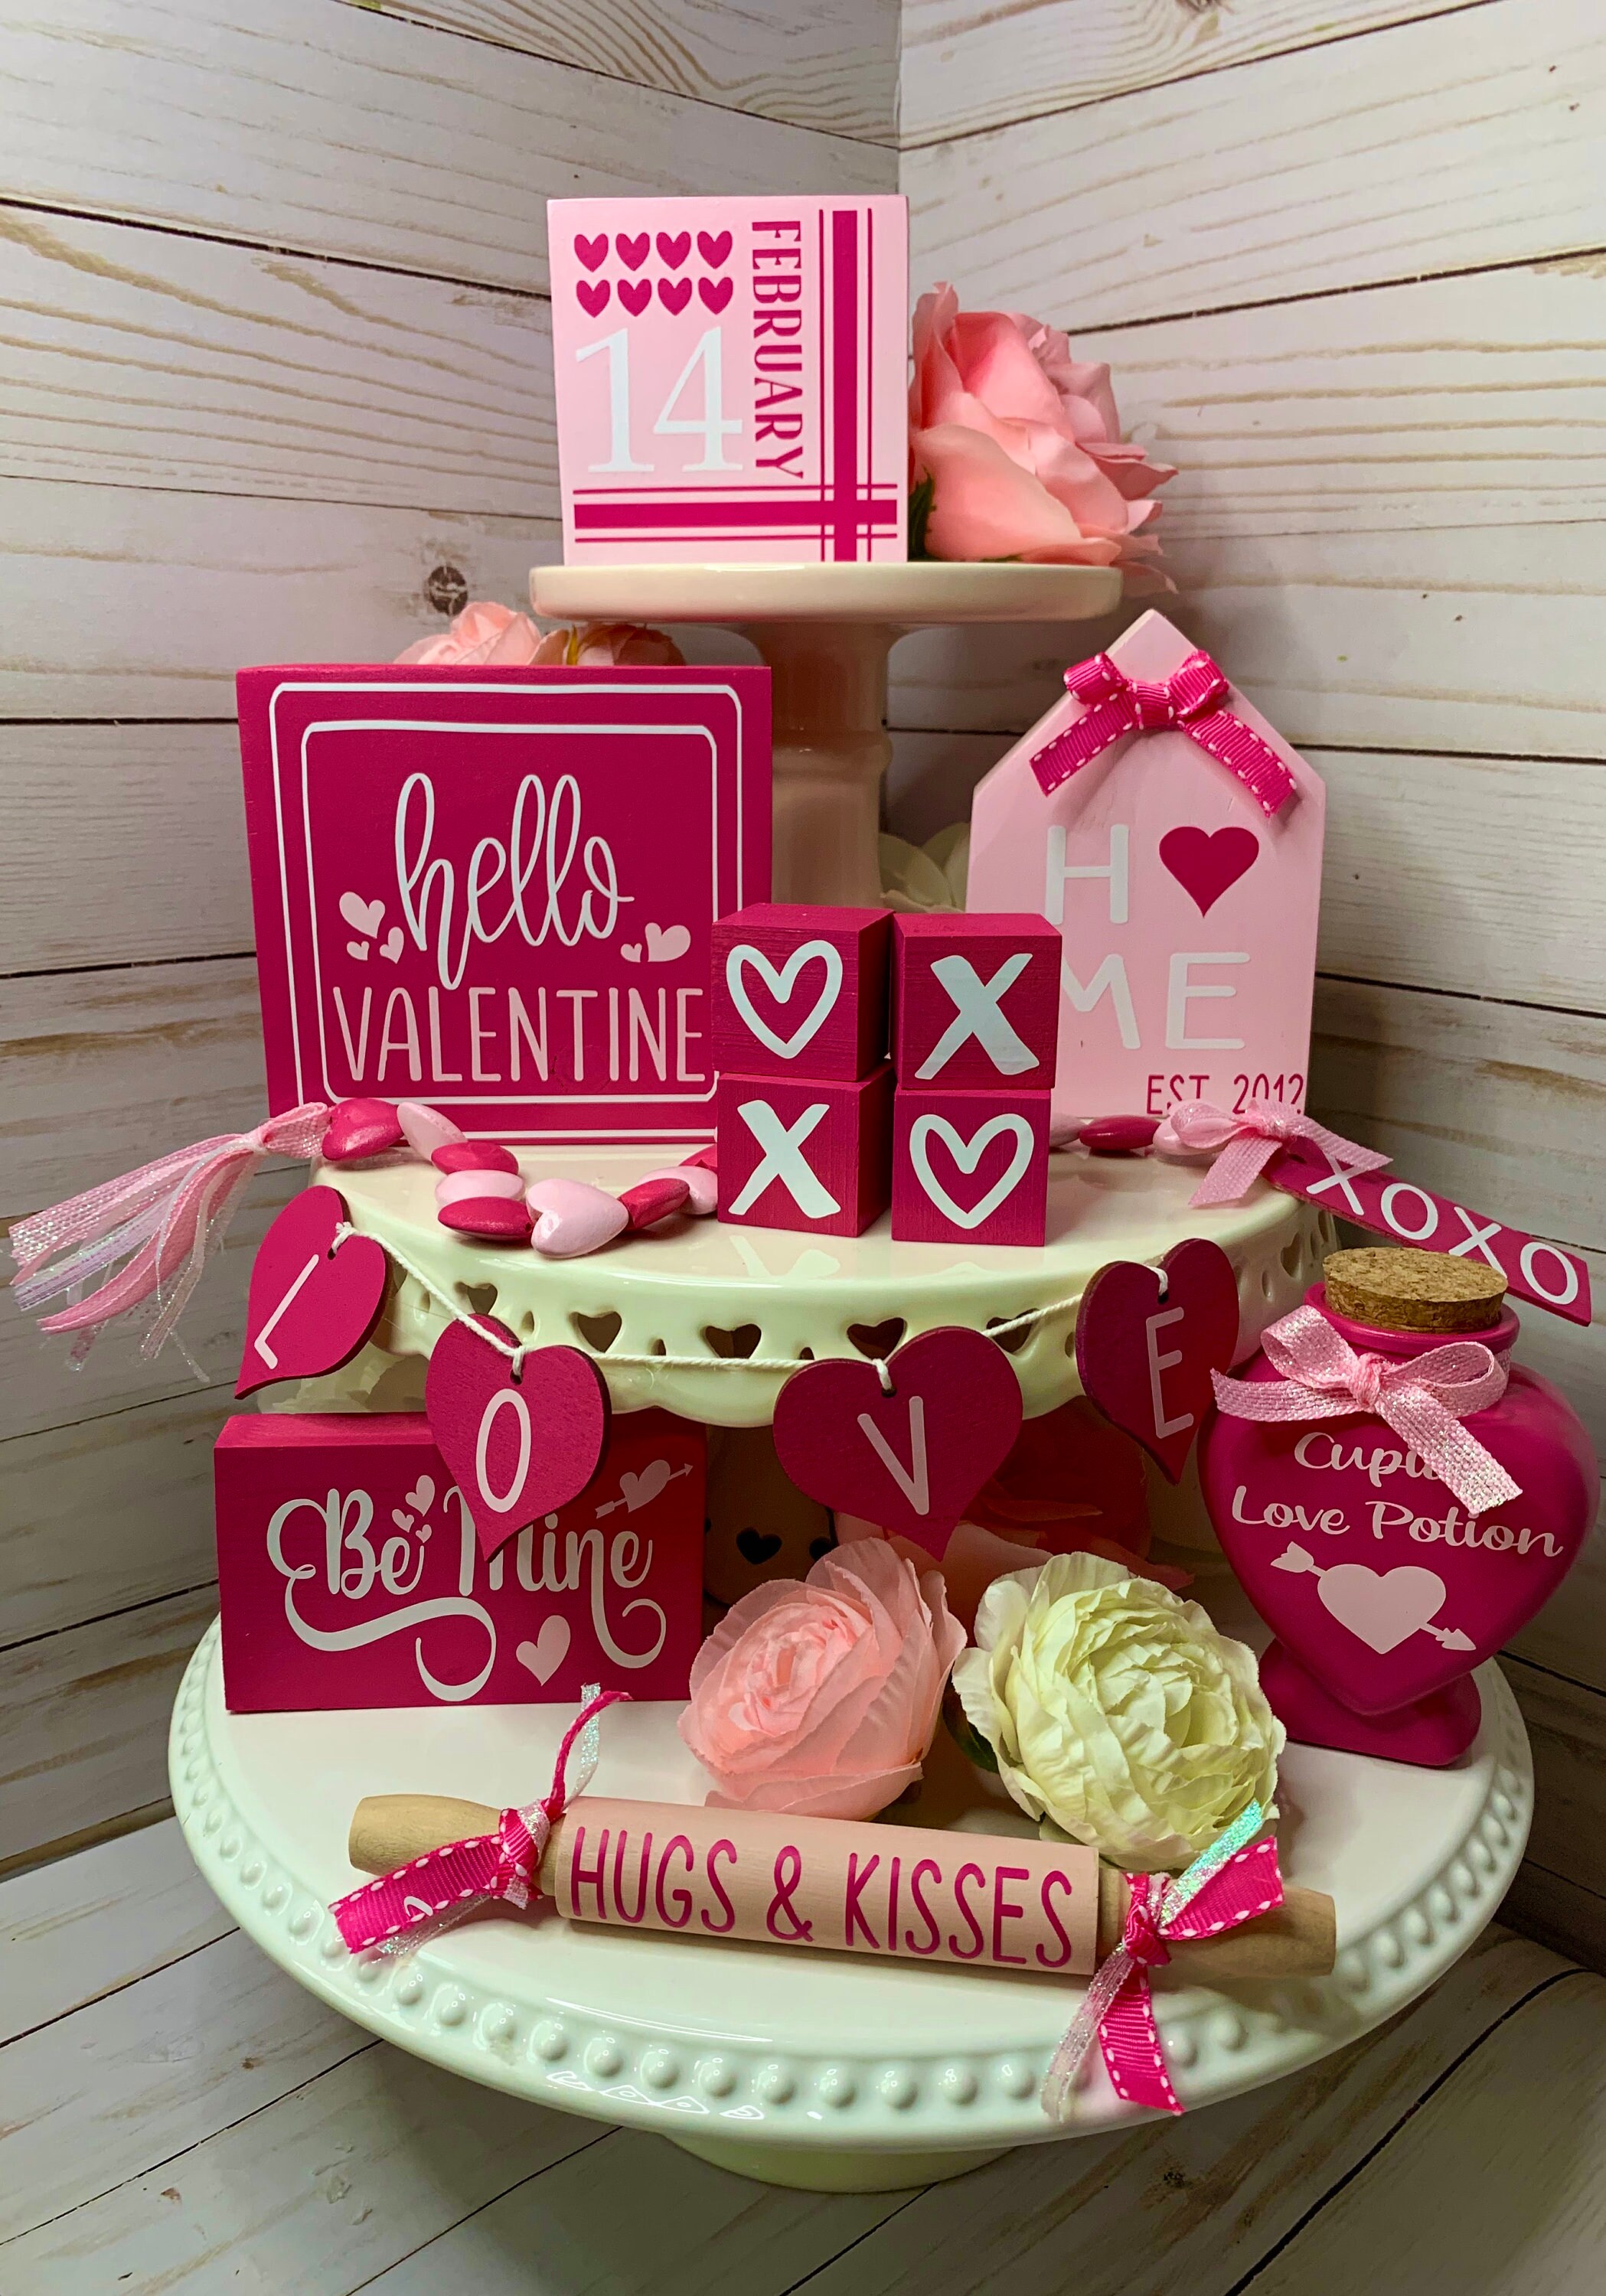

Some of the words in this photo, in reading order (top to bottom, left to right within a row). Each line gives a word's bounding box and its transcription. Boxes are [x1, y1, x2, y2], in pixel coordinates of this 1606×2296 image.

[575, 325, 744, 474] 14
[751, 220, 805, 480] FEBRUARY
[394, 771, 635, 990] hello
[332, 986, 707, 1083] VALENTINE
[914, 952, 1040, 1081] X
[1146, 1074, 1209, 1114] EST
[728, 1099, 842, 1219] X
[1305, 1151, 1579, 1306] XOXO
[1231, 1485, 1350, 1534] Love
[1365, 1500, 1564, 1558] Potion
[1294, 1431, 1440, 1488] Cupi
[570, 1826, 737, 1933] HUGS
[765, 1844, 813, 1942] &
[844, 1852, 1073, 1968] KISSES
